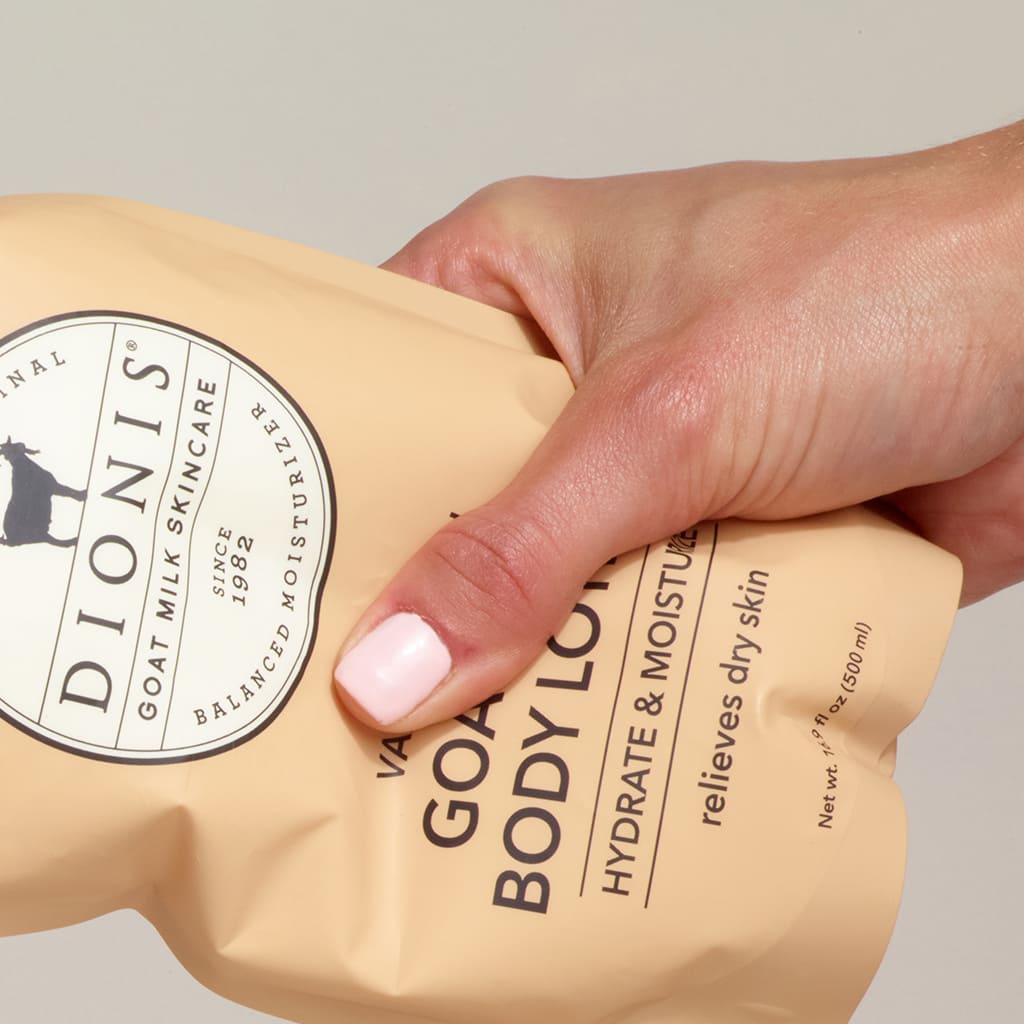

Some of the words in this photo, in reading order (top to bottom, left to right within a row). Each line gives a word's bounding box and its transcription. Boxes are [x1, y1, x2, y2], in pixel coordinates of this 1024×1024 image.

[167, 378, 216, 535] SKINCARE
[156, 549, 180, 621] MILK
[193, 624, 290, 727] BALANCED
[251, 402, 308, 611] MOISTURIZER
[213, 526, 232, 598] SINCE
[231, 535, 254, 607] 1982
[733, 569, 769, 628] skin
[719, 633, 762, 685] dry
[840, 651, 863, 693] (500
[854, 622, 872, 650] ml)
[138, 635, 169, 721] GOAT
[829, 695, 847, 714] oz
[814, 713, 829, 726] fl
[422, 692, 504, 848] GOA
[602, 726, 658, 896] HYDRATE
[633, 691, 664, 717] &
[696, 694, 743, 826] relieves
[826, 764, 837, 789] wt.
[492, 706, 580, 914] BODY
[818, 795, 836, 829] Net
